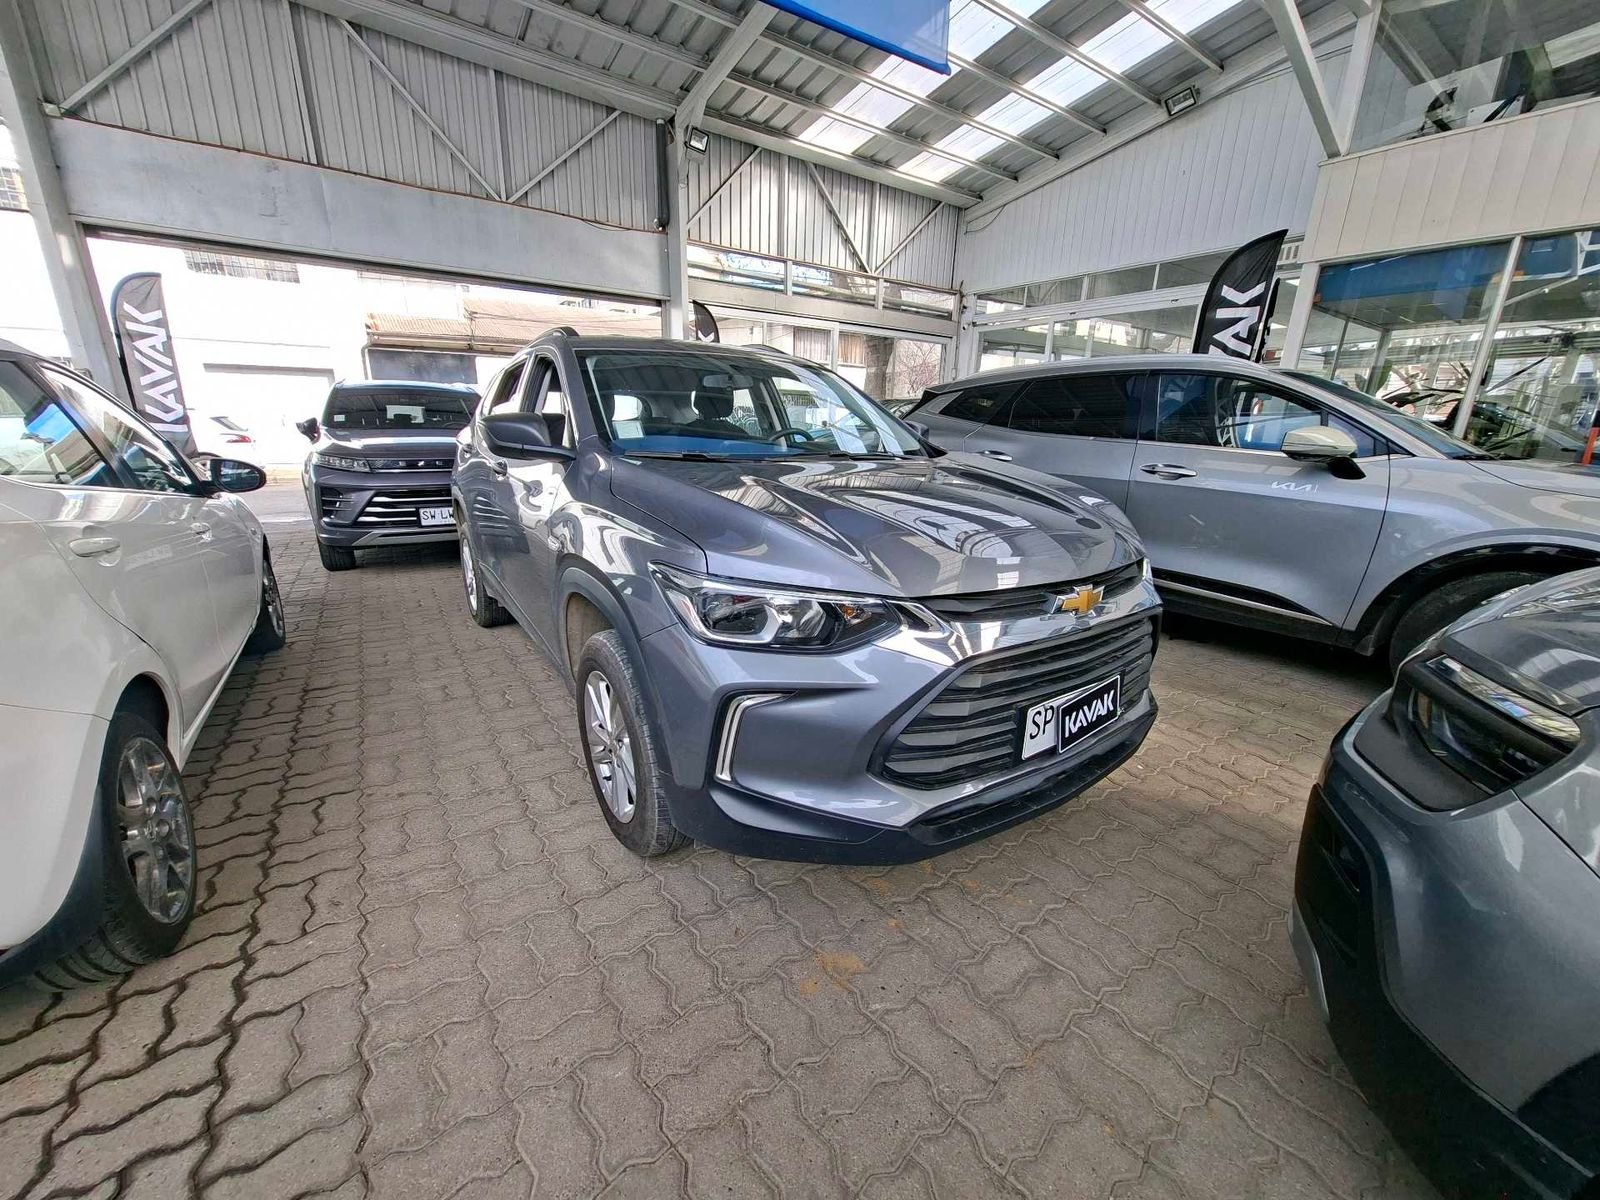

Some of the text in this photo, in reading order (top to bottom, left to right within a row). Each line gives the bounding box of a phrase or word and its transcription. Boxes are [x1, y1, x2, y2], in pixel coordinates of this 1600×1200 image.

[123, 302, 189, 432] KAVAK
[422, 510, 436, 520] SW
[1029, 704, 1055, 740] SP
[1064, 689, 1115, 738] KAVAK
